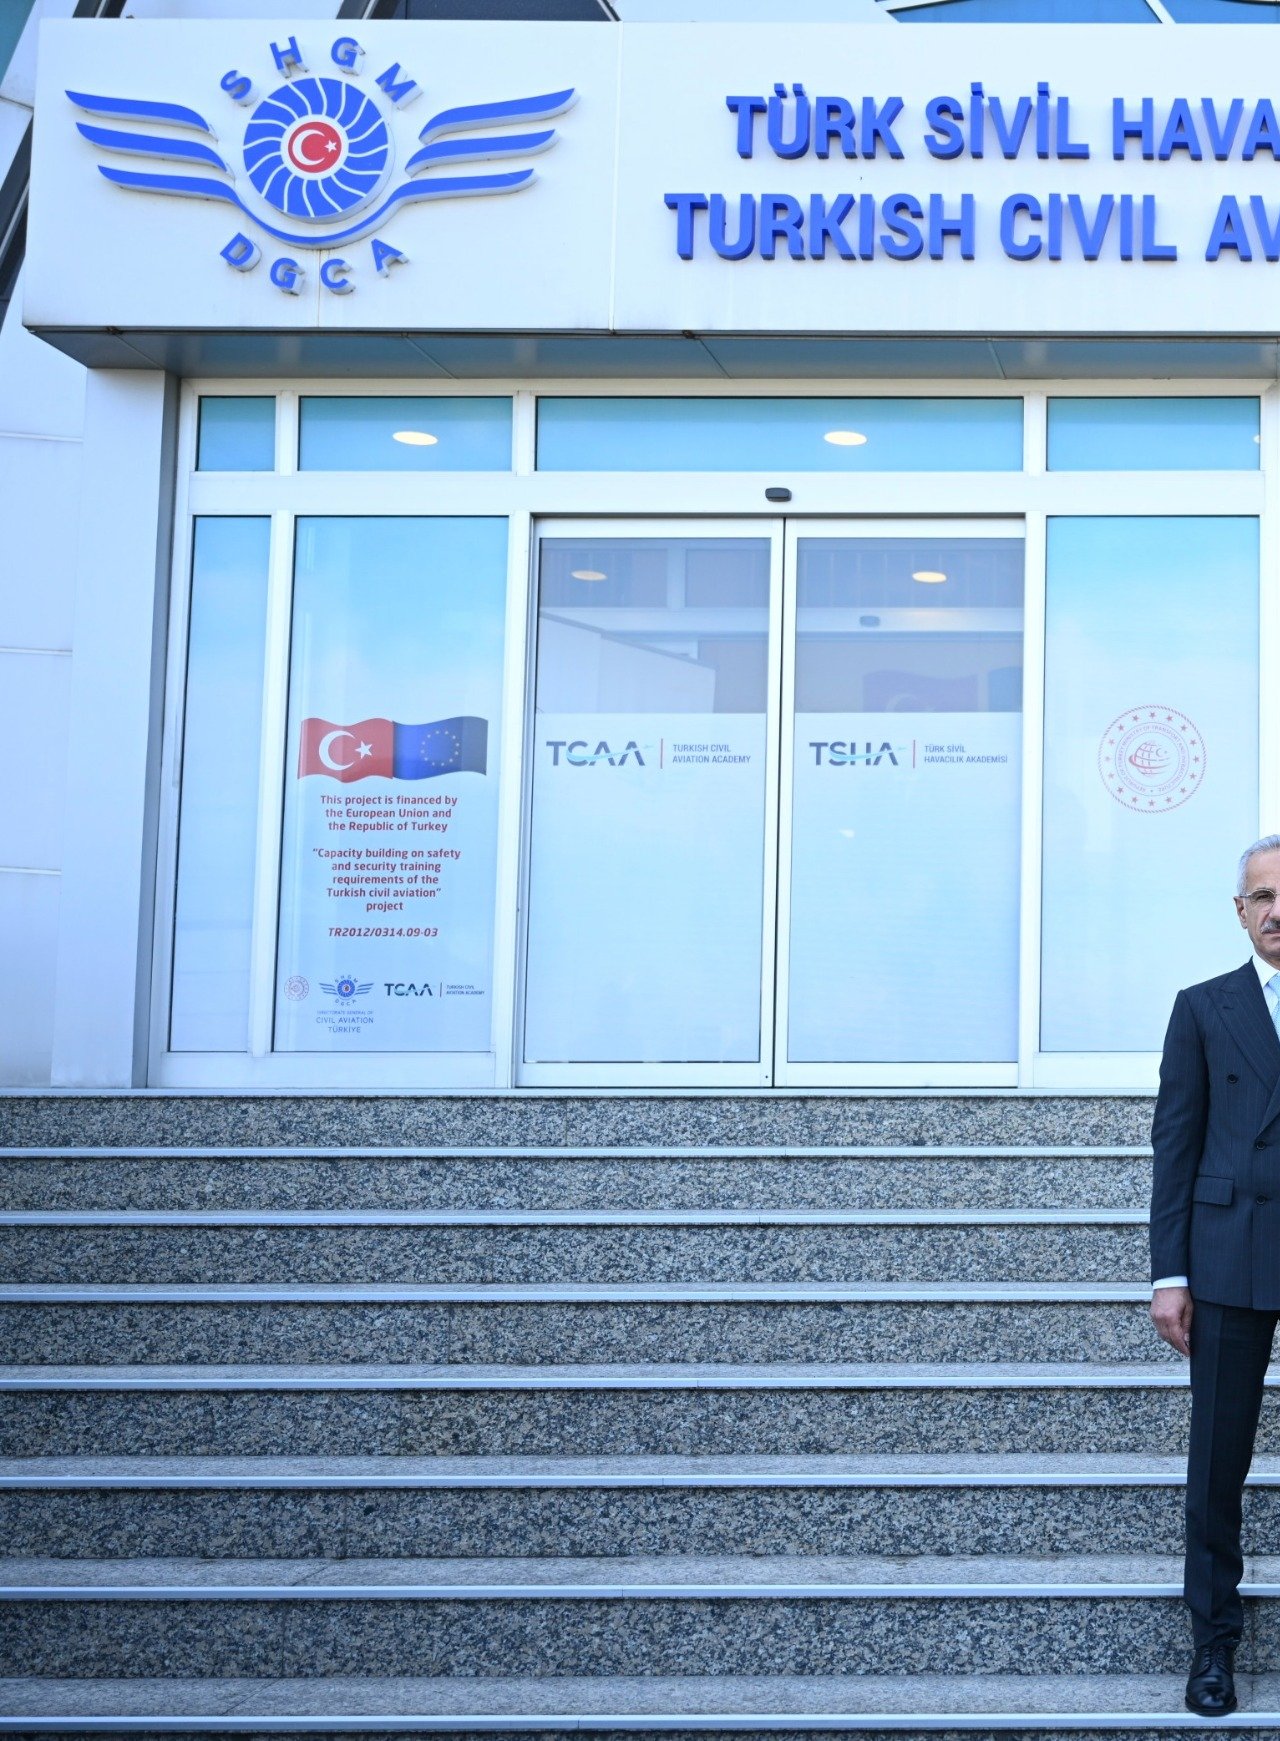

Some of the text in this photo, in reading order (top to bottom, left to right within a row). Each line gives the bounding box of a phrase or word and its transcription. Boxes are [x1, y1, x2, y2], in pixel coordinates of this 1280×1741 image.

[219, 35, 426, 109] SHGM
[725, 82, 904, 159] TÜRK
[924, 82, 1090, 159] SİVİL
[664, 193, 975, 261] TURKISH
[1000, 193, 1178, 262] CIVIL
[219, 232, 409, 296] DGCA
[546, 740, 645, 766] TCAA
[673, 744, 731, 752] TURKISH CIVIL
[925, 744, 966, 753] TÜRK SİVİL
[809, 741, 898, 766] TSHA
[673, 756, 751, 764] AVIATION ACADEMY
[966, 755, 1008, 763] AKADEMİSİ
[321, 795, 457, 806] This project is financed by
[326, 809, 451, 819] the European Union and
[329, 822, 447, 832] the Republic of Turkey
[366, 848, 408, 859] building
[411, 850, 424, 858] on
[428, 849, 460, 859] safety
[332, 862, 441, 873] and security training
[333, 875, 438, 885] requirements of the
[327, 888, 365, 897] Turkish
[369, 888, 389, 897] civil
[366, 902, 403, 912] project
[384, 983, 433, 996] TCAA
[328, 1025, 361, 1033] TÜRKİYE
